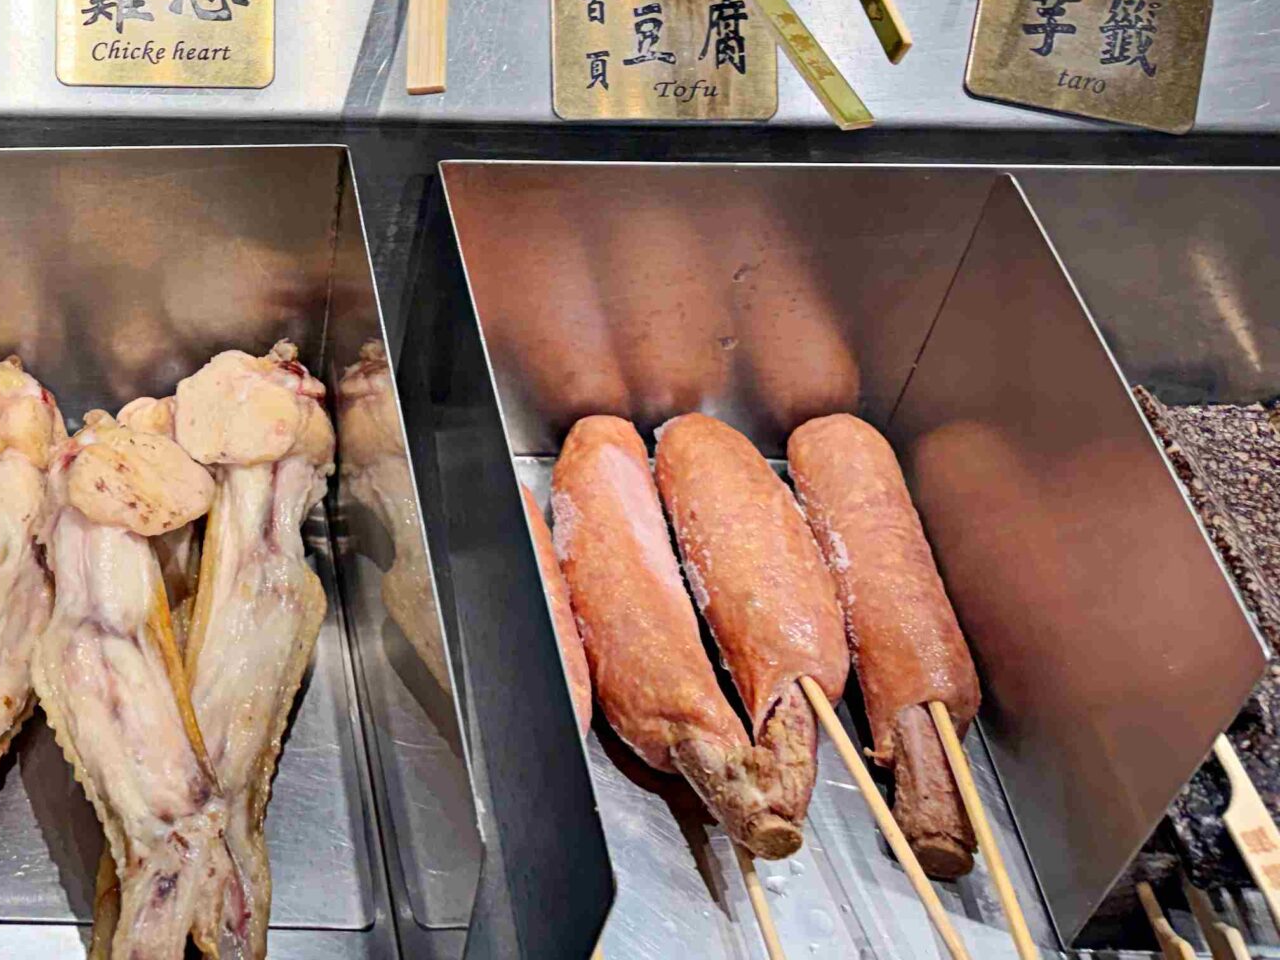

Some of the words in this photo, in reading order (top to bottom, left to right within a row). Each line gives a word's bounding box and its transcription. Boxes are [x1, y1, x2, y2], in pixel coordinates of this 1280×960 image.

[91, 40, 165, 64] Chicke
[172, 41, 231, 61] heart
[653, 79, 719, 102] Tofu
[1057, 69, 1107, 94] taro
